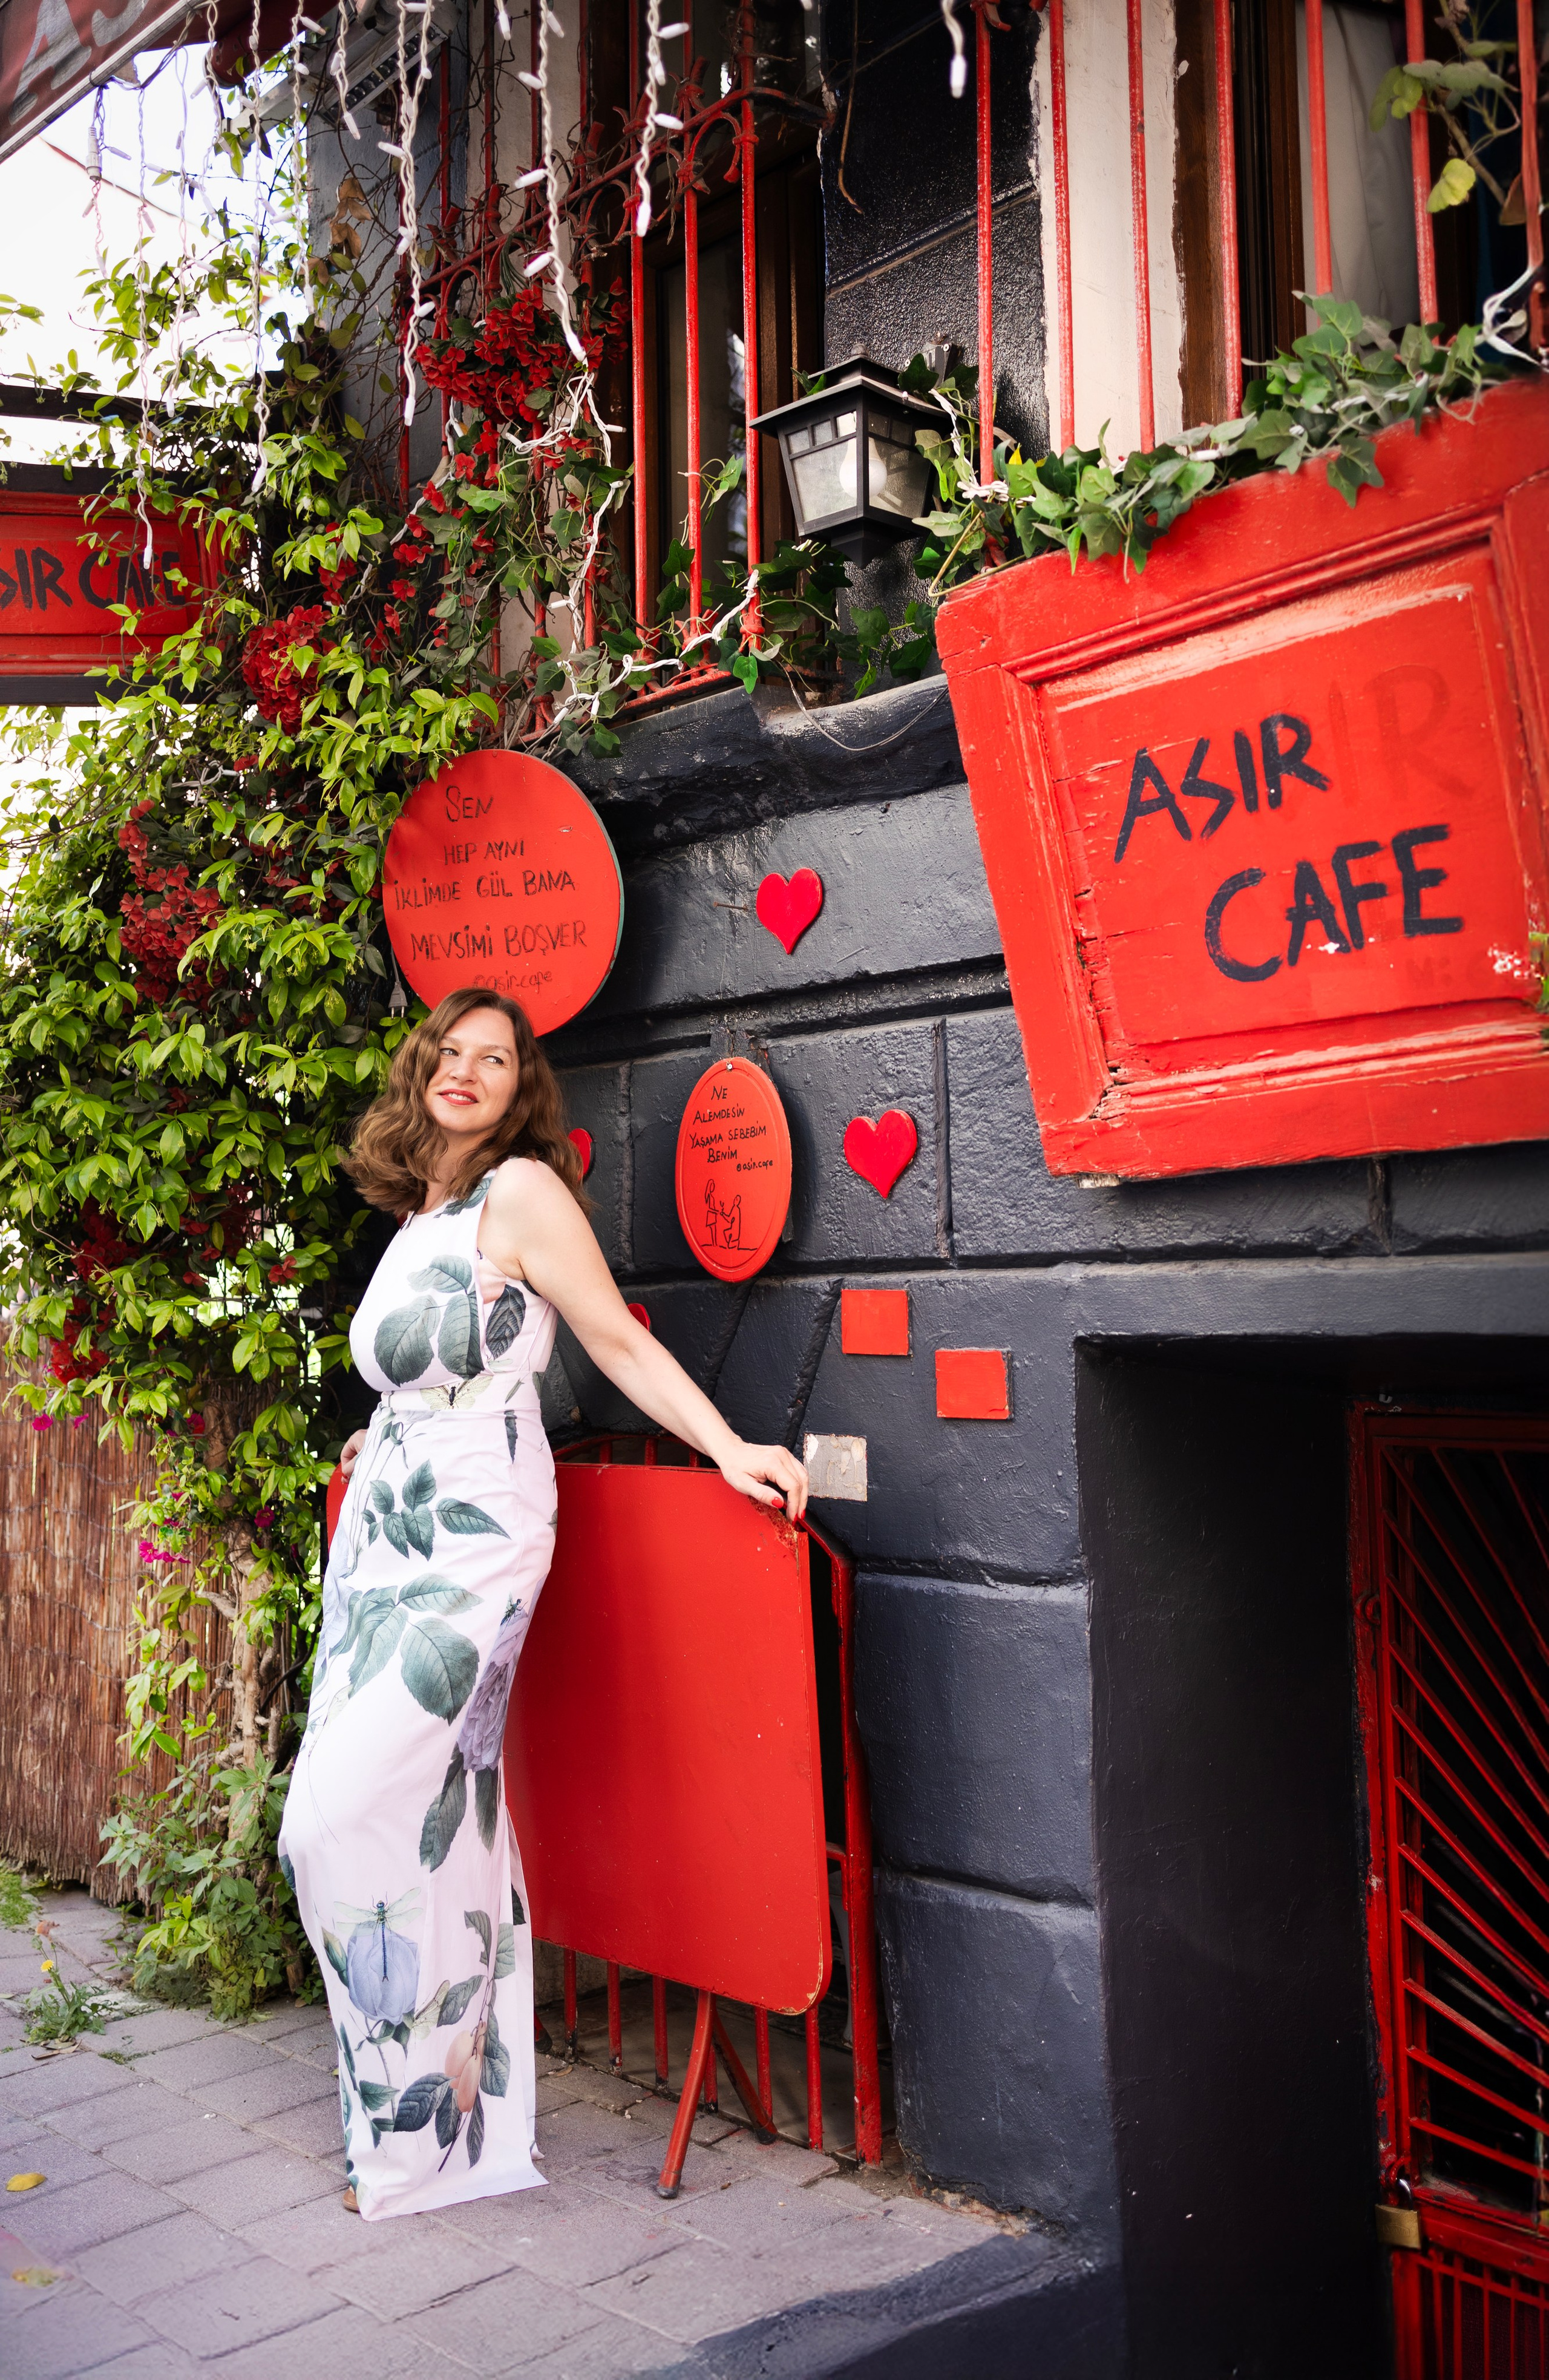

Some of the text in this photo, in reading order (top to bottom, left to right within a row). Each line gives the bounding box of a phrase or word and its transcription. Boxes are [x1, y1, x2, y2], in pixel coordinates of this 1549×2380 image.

[79, 551, 186, 610] CAFE
[445, 785, 494, 822] SEN
[1113, 712, 1332, 864] ASIR
[444, 839, 524, 865] HEP AYNI
[476, 870, 513, 898] GÜL
[522, 870, 576, 896] BANA
[1204, 823, 1466, 984] CAFE
[504, 920, 588, 956] BOŞVER
[710, 1085, 728, 1100] NE
